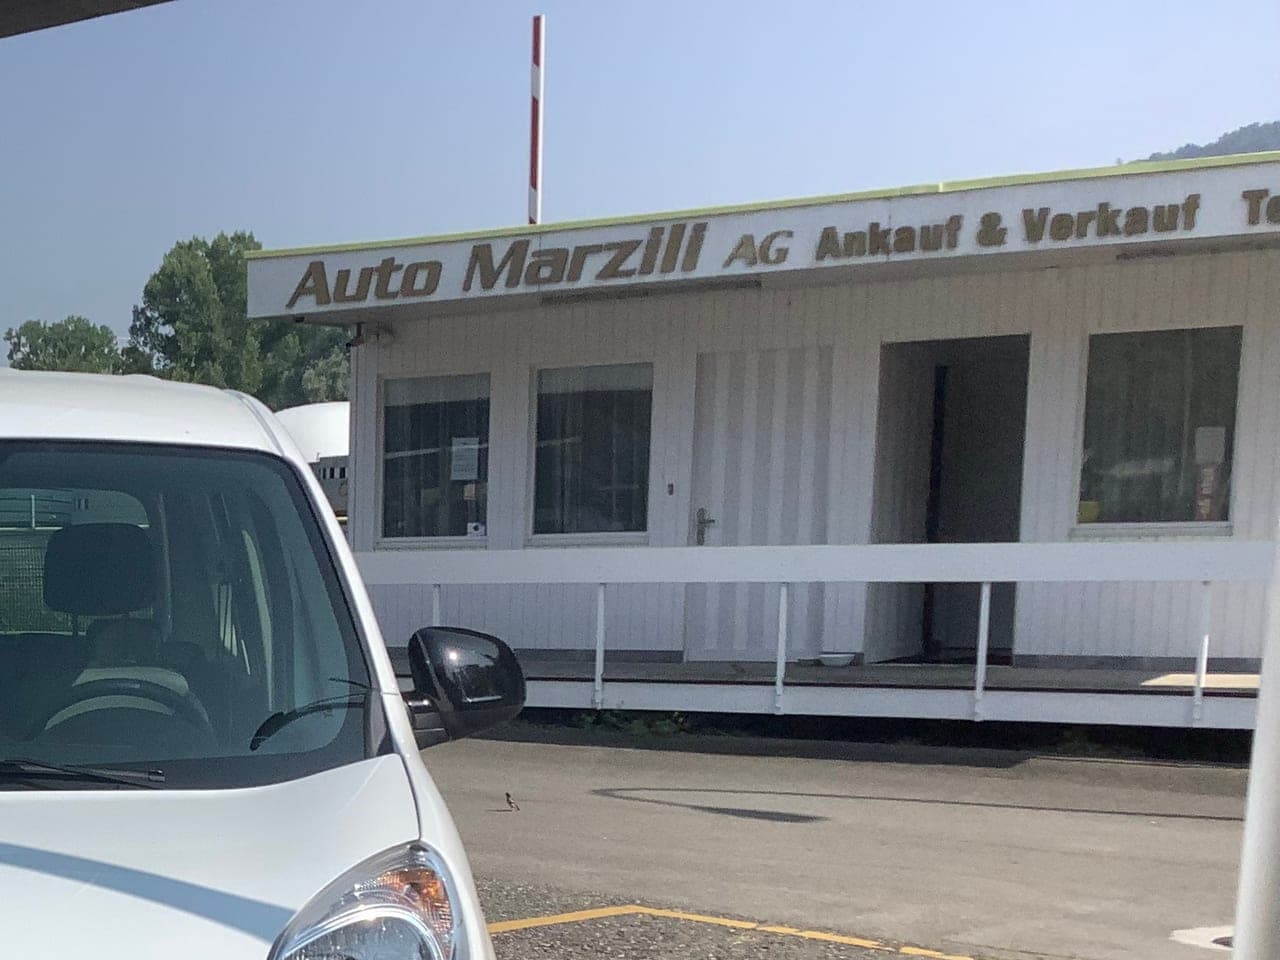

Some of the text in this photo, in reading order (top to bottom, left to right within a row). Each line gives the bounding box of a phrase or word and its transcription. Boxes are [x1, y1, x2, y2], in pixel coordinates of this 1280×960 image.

[286, 258, 442, 309] Auto
[462, 222, 708, 292] Marzili
[723, 230, 793, 268] AG
[816, 215, 962, 261] Ankauf
[976, 212, 1007, 247] &
[1022, 194, 1200, 243] Verkauf
